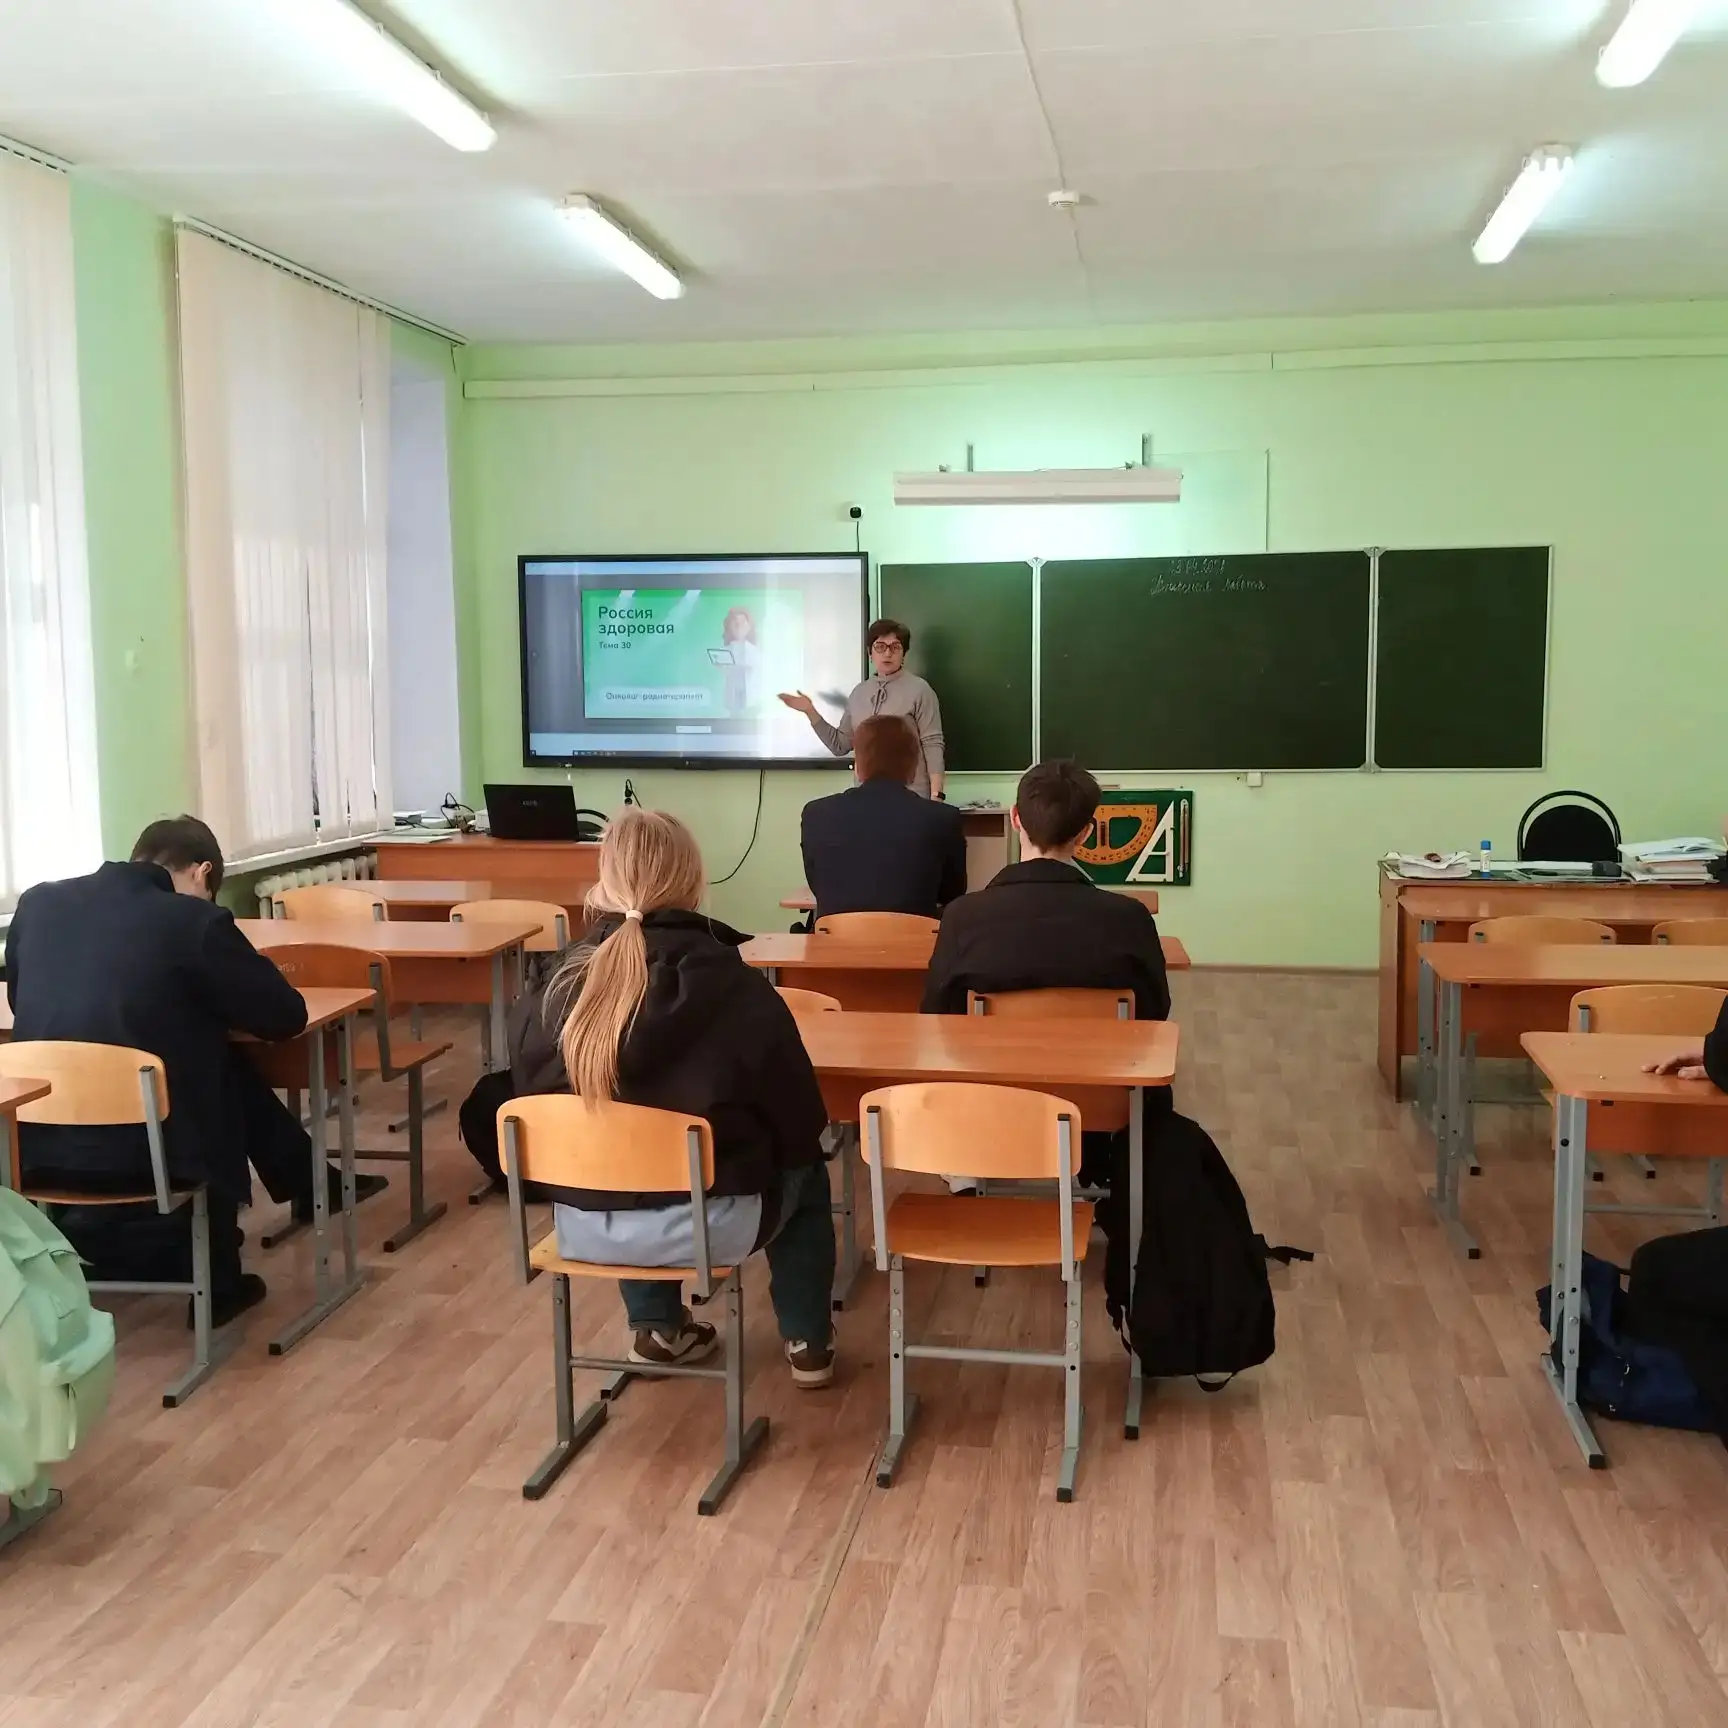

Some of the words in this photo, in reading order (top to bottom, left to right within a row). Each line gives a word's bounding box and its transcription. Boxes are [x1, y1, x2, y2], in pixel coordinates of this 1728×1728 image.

[598, 606, 653, 619] Россия
[598, 624, 674, 637] здоровая
[599, 641, 619, 649] Тема
[621, 641, 632, 649] 30
